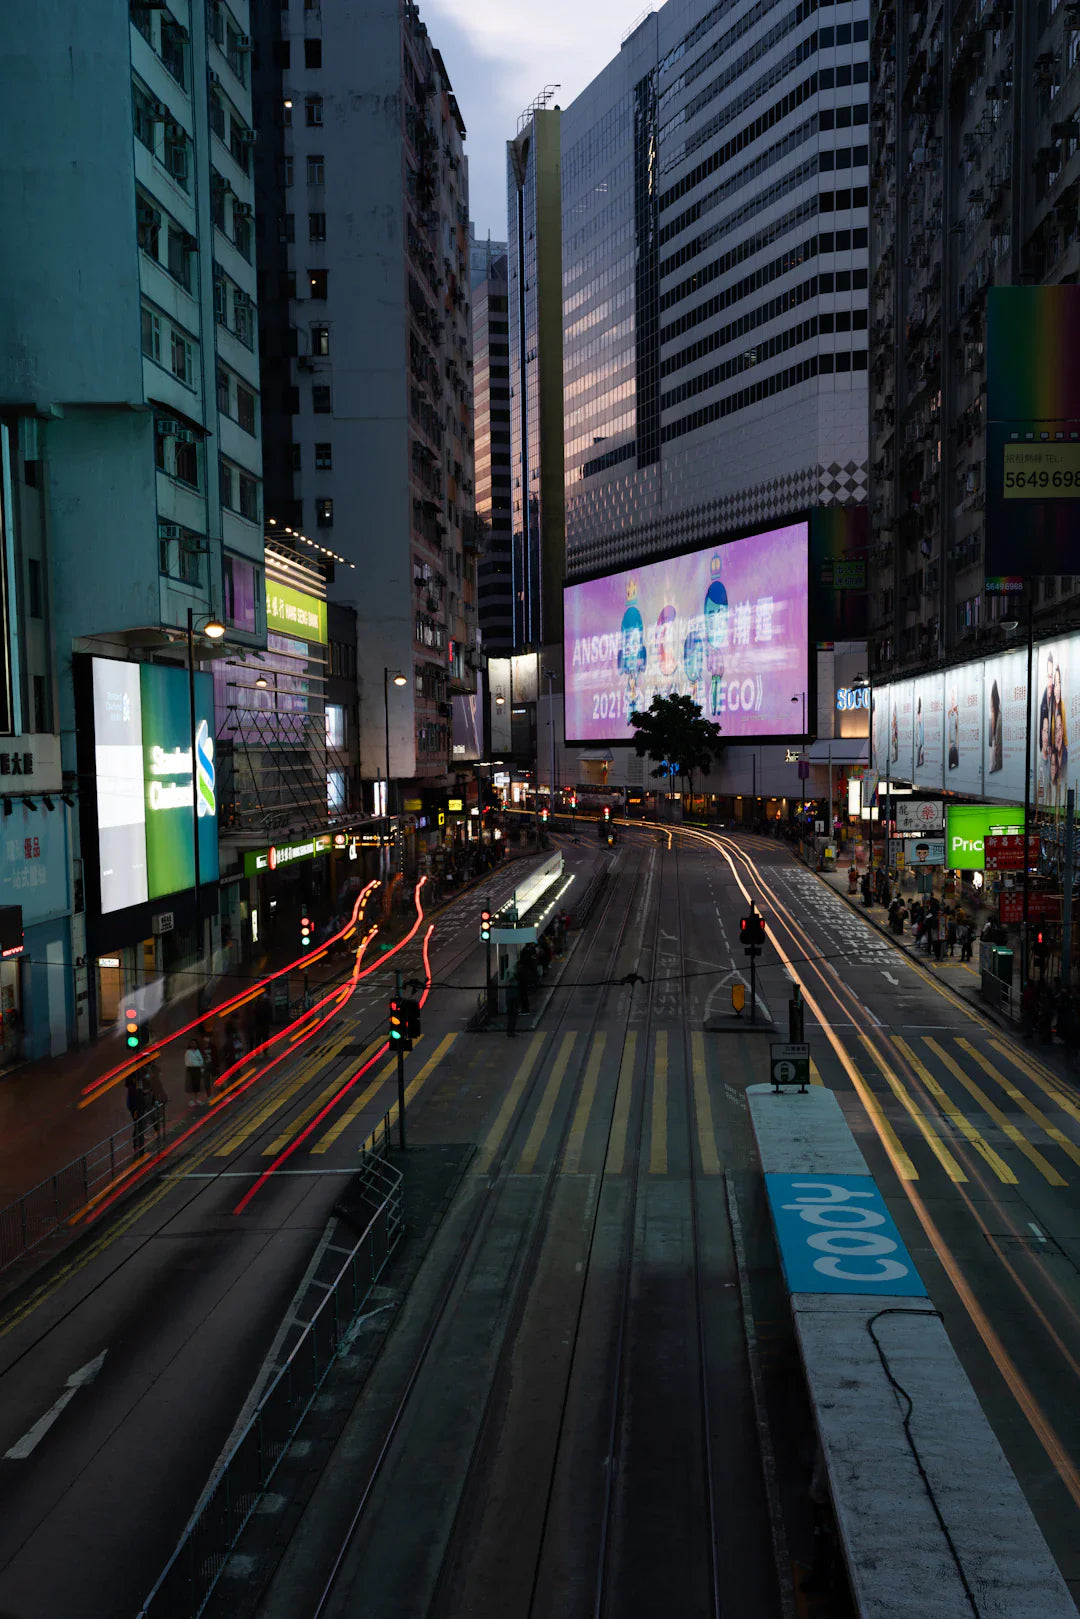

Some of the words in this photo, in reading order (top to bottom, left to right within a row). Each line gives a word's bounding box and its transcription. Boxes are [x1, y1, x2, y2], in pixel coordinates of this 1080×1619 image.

[573, 632, 620, 667] ANSON
[837, 686, 871, 711] SOGO
[781, 1182, 909, 1281] cody
